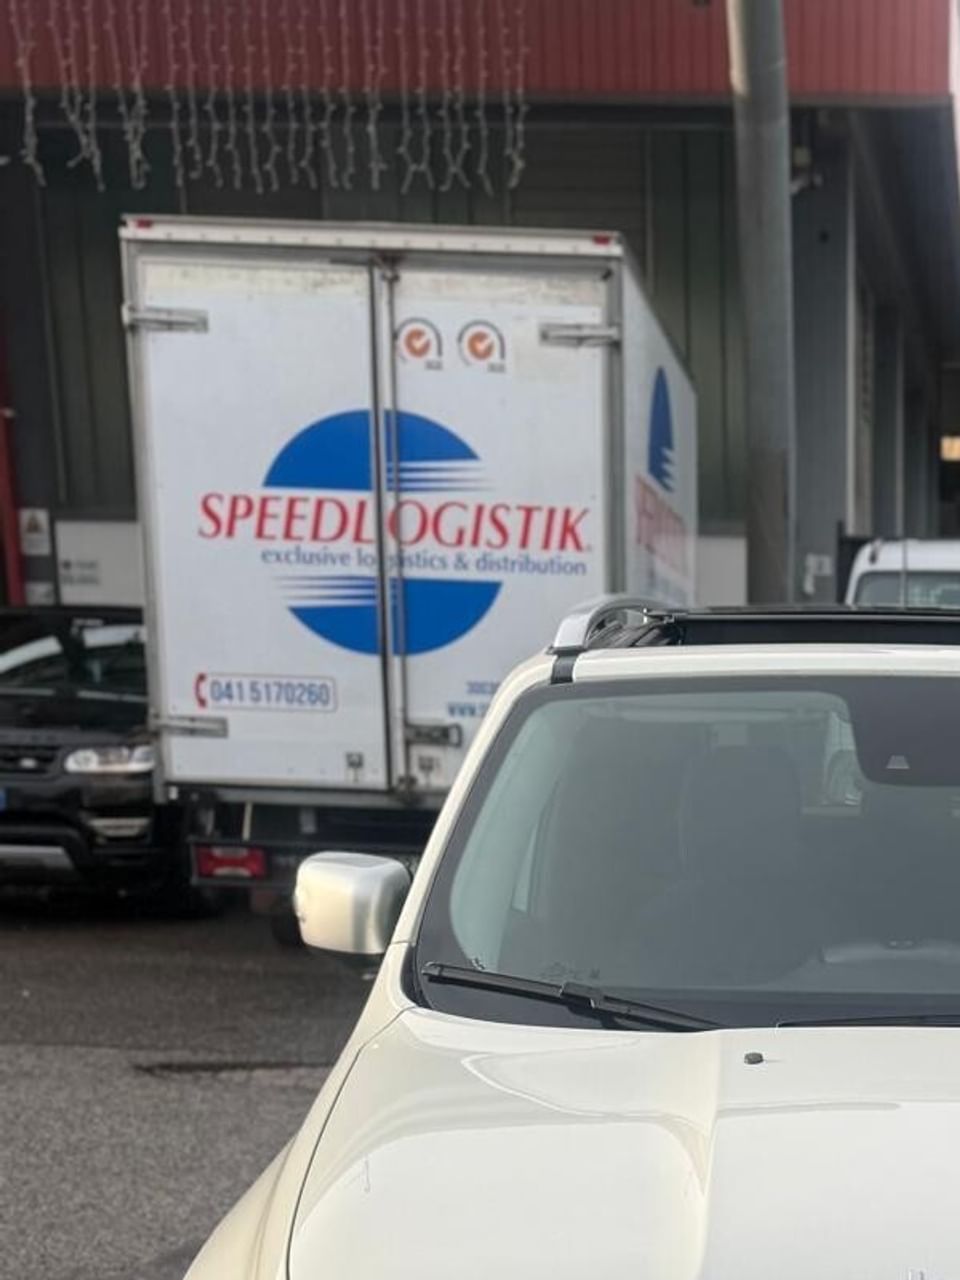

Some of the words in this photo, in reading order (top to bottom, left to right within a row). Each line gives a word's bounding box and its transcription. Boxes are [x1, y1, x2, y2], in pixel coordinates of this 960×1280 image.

[198, 492, 590, 552] SPEEDLOGISTIK
[261, 545, 351, 567] exclusive
[453, 551, 469, 572] &
[475, 550, 587, 576] distribution
